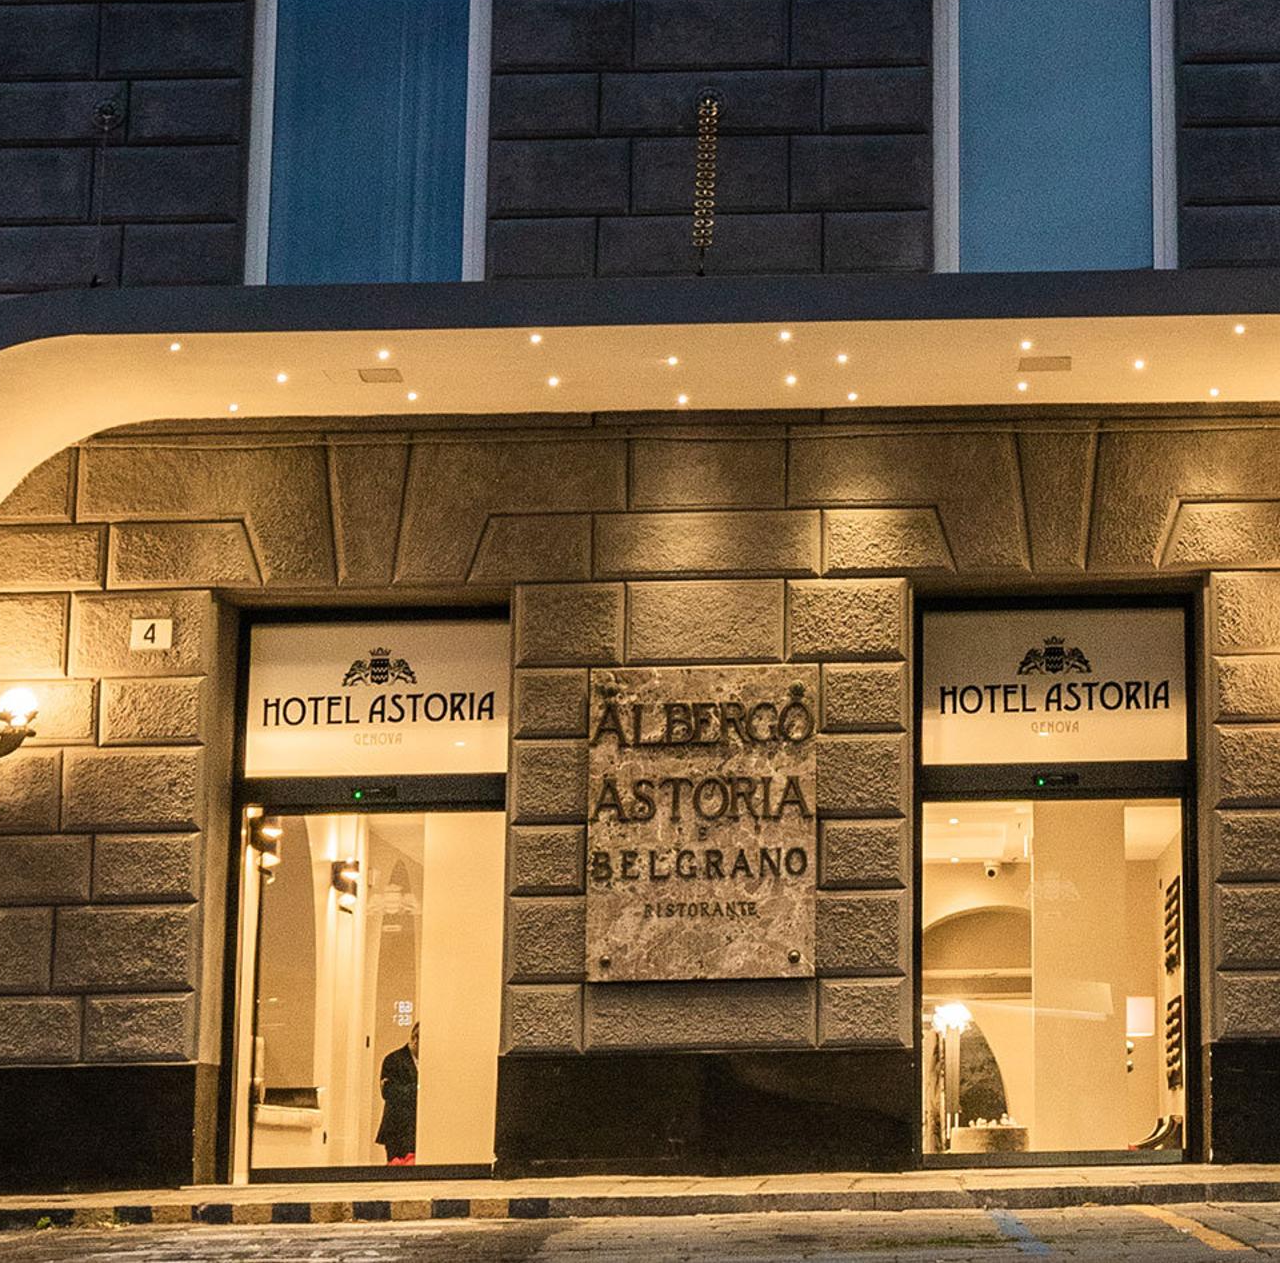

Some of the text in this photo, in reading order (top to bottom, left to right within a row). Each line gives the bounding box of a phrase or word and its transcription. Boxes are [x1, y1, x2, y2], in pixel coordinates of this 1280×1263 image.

[143, 622, 156, 644] 4
[262, 690, 496, 727] HOTEL ASTORIA
[939, 679, 1171, 715] HOTEL ASTORIA
[353, 732, 403, 746] GENOVA
[590, 700, 815, 747] ALBERGO
[1030, 720, 1080, 734] GENOVA
[590, 775, 815, 823] ASTORIA
[590, 846, 809, 882] BELGRANO
[643, 900, 761, 919] RISTORANTE
